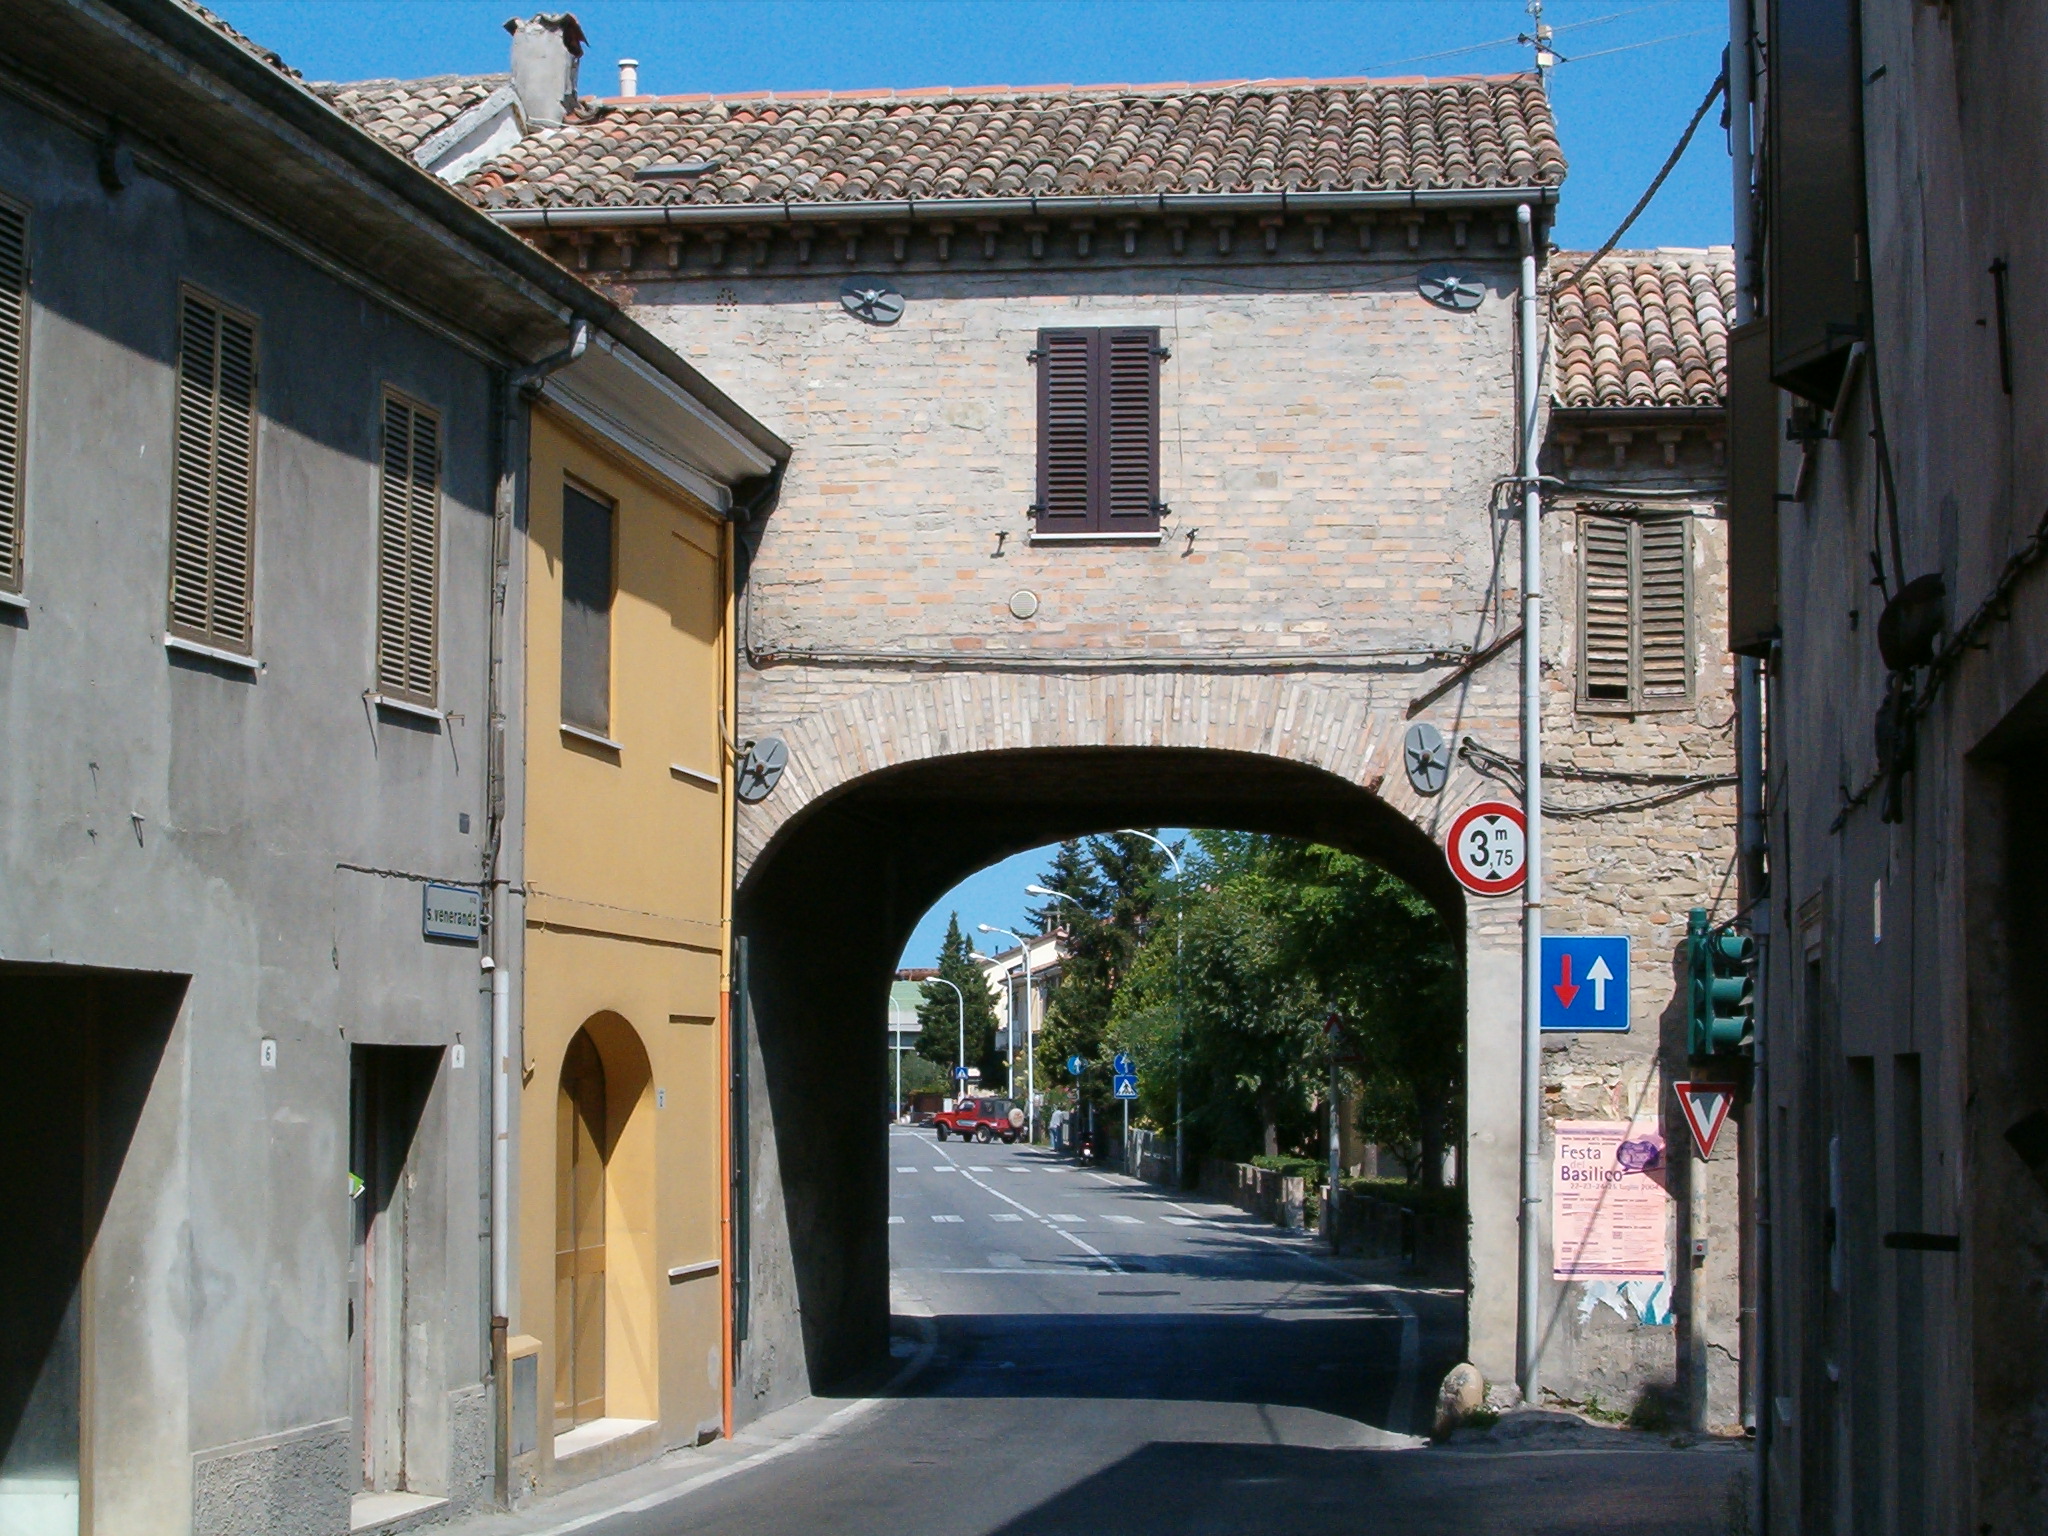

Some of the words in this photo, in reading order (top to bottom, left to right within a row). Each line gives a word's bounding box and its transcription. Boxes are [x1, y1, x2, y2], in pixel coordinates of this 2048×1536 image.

[1495, 829, 1508, 841] m
[265, 1046, 271, 1062] 6
[1561, 1144, 1602, 1160] Festa
[1570, 1160, 1585, 1169] del
[1561, 1165, 1623, 1182] Basilico
